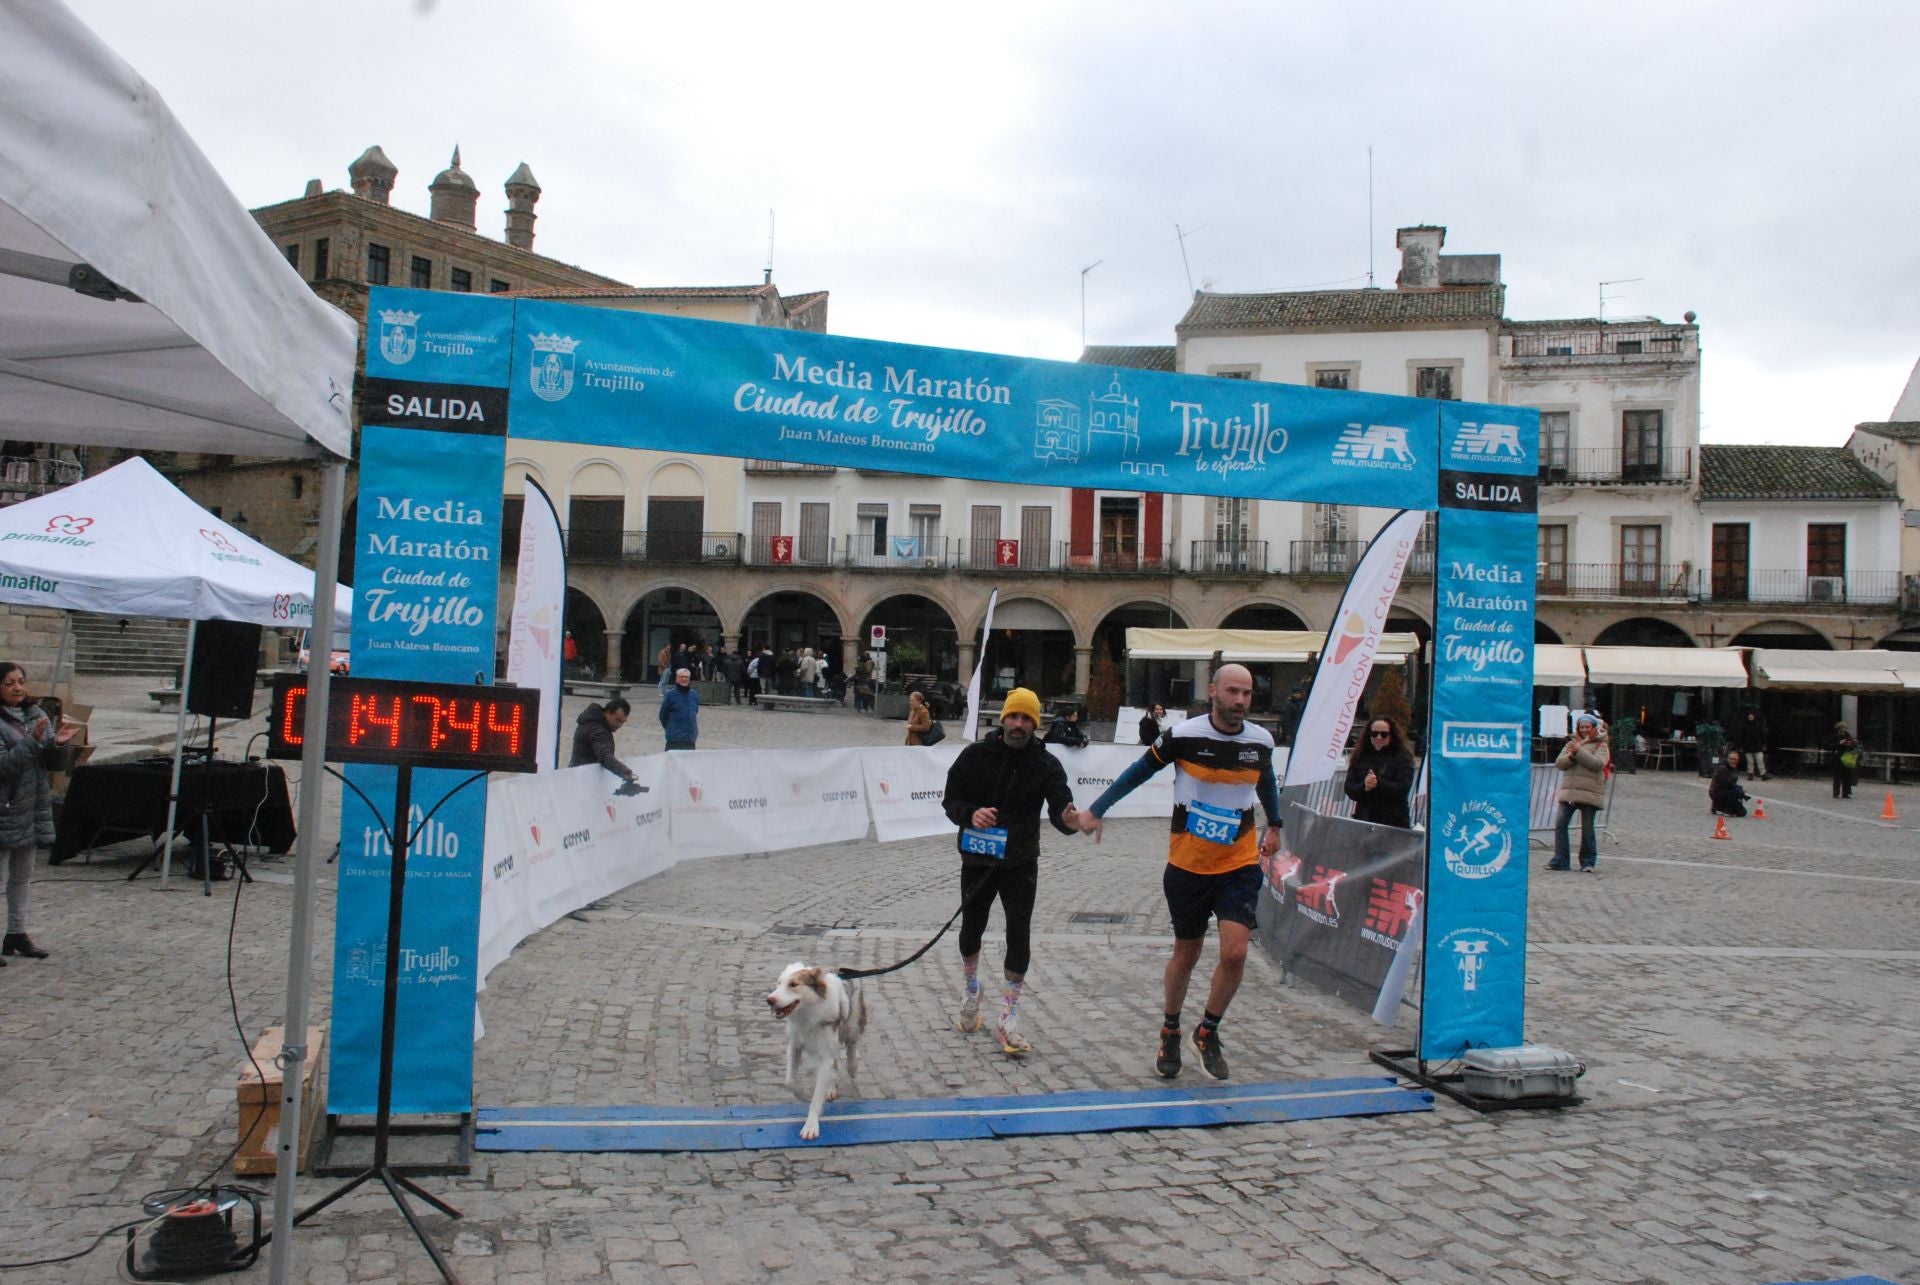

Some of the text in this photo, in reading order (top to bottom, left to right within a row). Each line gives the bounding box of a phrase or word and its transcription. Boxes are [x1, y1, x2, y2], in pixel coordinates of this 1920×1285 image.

[424, 330, 486, 344] Ayuntamiento
[423, 341, 474, 356] Trujillo
[584, 359, 676, 378] Ayuntamiento de
[772, 353, 1012, 405] Media Maratón
[583, 373, 645, 393] Trujillo
[387, 394, 485, 422] SALIDA
[734, 382, 987, 442] Ciudad de Trujillo
[778, 425, 936, 453] Juan Mateos Broncano
[1170, 401, 1289, 465] Trujillo
[1196, 451, 1210, 472] te
[1331, 457, 1414, 471] www.musicrun.es
[1450, 451, 1523, 465] www.musicrun.es
[1455, 482, 1522, 503] SALIDA
[376, 496, 484, 526] Media
[0, 533, 96, 547] primaflor
[367, 533, 490, 561] Maratón
[382, 566, 471, 588] Ciudad de
[1450, 561, 1523, 584] Media
[364, 588, 484, 636] Trujillo
[1445, 591, 1529, 612] Maratón
[1454, 616, 1514, 634] Ciudad de
[368, 638, 480, 653] Juan Mateos Broncano
[1366, 626, 1378, 649] DE
[1443, 634, 1525, 672] Trujillo
[1453, 732, 1510, 749] HABLA
[1442, 799, 1507, 837] Club Atletismo
[1196, 820, 1229, 842] 534
[969, 836, 996, 856] 533
[400, 946, 460, 972] Trujillo
